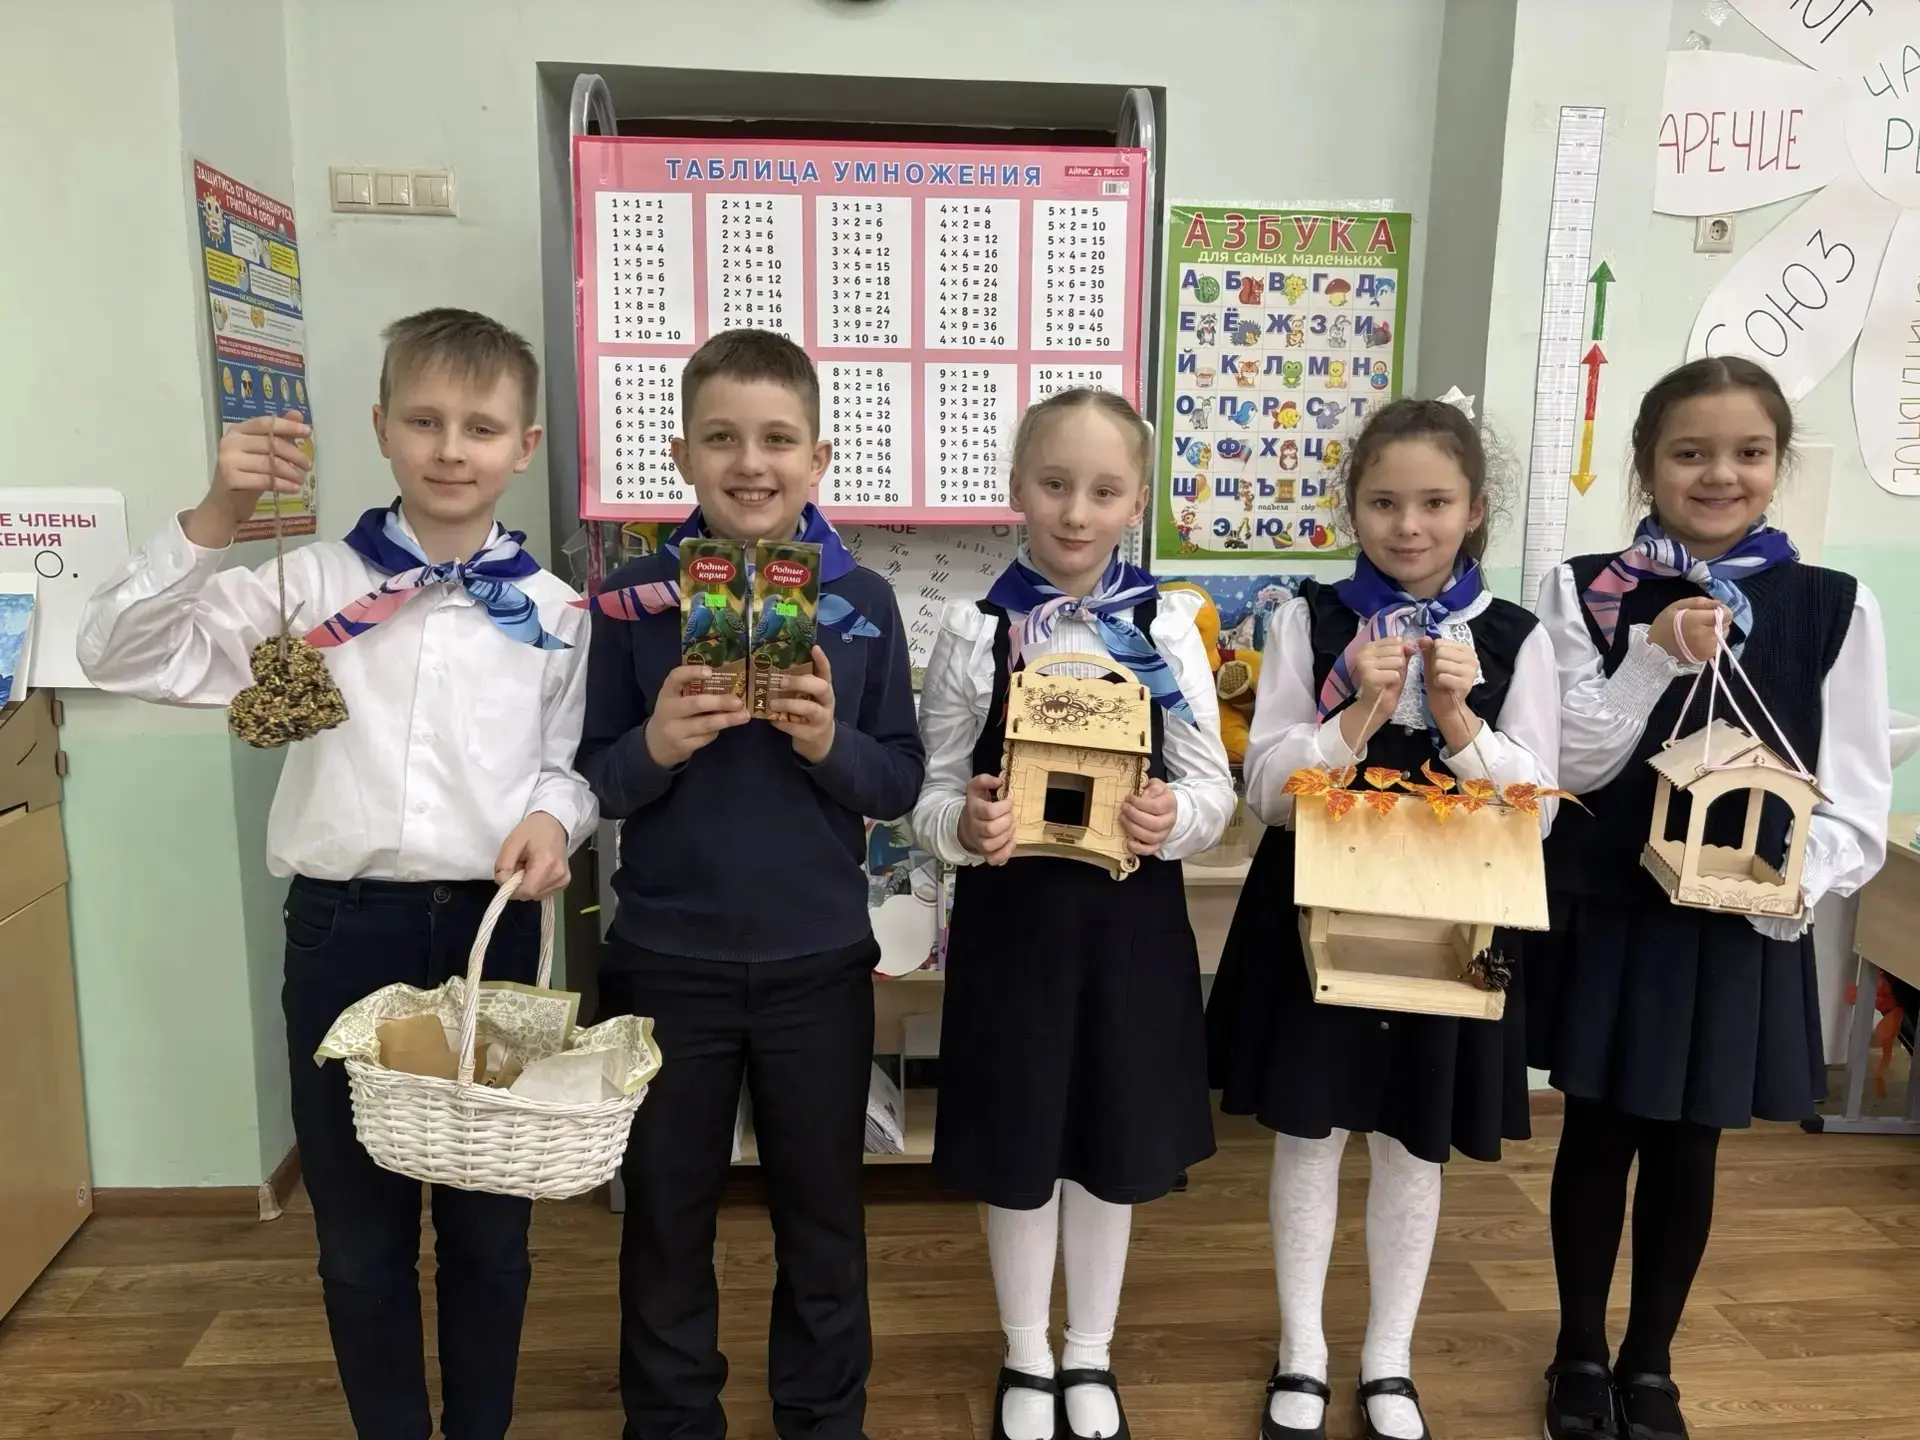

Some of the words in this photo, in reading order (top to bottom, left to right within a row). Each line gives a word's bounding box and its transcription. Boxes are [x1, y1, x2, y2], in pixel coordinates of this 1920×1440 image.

[665, 158, 820, 185] ТАБЛИЦА
[832, 161, 1042, 188] УМНОЖЕНИЯ
[1103, 168, 1125, 176] ПРЕСС
[612, 198, 618, 208] 1
[635, 199, 641, 208] 1
[657, 199, 663, 209] 1
[832, 217, 838, 227] 3
[854, 217, 861, 227] 2
[876, 217, 883, 227] 6
[1182, 212, 1396, 254] АЗБУКА
[940, 234, 947, 243] 4
[962, 234, 969, 244] 3
[985, 234, 998, 244] 12
[1198, 251, 1229, 263] для
[1234, 253, 1286, 264] самых
[1292, 254, 1382, 266] маленьких
[1047, 265, 1054, 274] 5
[1069, 265, 1076, 274] 5
[1090, 265, 1105, 275] 25
[1181, 269, 1198, 289] А
[1225, 271, 1241, 290] Б
[1268, 272, 1284, 291] В
[1312, 273, 1328, 292] Г
[1355, 274, 1375, 297] Д
[723, 288, 730, 298] 2
[746, 288, 752, 298] 7
[768, 289, 783, 299] 14
[1180, 312, 1196, 331] Е
[1223, 308, 1239, 332] Ё
[1266, 314, 1293, 333] Ж
[1309, 315, 1326, 334] З
[1354, 316, 1373, 335] И
[614, 329, 620, 338] 1
[637, 330, 651, 339] 10
[667, 330, 681, 340] 10
[832, 333, 839, 343] 3
[855, 334, 869, 343] 10
[884, 334, 898, 344] 30
[939, 335, 947, 344] 4
[962, 335, 976, 345] 10
[990, 336, 1005, 345] 40
[1046, 336, 1052, 346] 5
[1068, 337, 1082, 346] 10
[1096, 337, 1110, 347] 50
[1178, 349, 1196, 373] Й
[1221, 355, 1239, 374] К
[1263, 356, 1283, 375] Л
[1308, 357, 1330, 376] М
[1352, 358, 1370, 376] Н
[1039, 370, 1053, 380] 10
[1068, 371, 1073, 379] 1
[1089, 370, 1102, 380] 10
[939, 397, 946, 407] 9
[961, 397, 968, 407] 3
[983, 397, 996, 407] 27
[1176, 395, 1194, 415] О
[1219, 397, 1237, 415] П
[1262, 397, 1279, 416] Р
[1306, 397, 1323, 416] С
[1350, 398, 1366, 417] Т
[1174, 437, 1191, 456] У
[1217, 437, 1241, 457] Ф
[1259, 438, 1278, 457] Х
[1304, 438, 1322, 460] Ц
[833, 451, 841, 461] 8
[856, 451, 862, 461] 7
[877, 452, 891, 461] 56
[1173, 478, 1197, 497] Ш
[1215, 478, 1239, 499] Щ
[1257, 478, 1275, 497] Ъ
[1301, 479, 1326, 497] Ы
[616, 490, 623, 500] 6
[639, 490, 653, 500] 10
[668, 490, 683, 500] 60
[833, 492, 841, 502] 8
[856, 493, 870, 502] 10
[884, 493, 899, 502] 80
[940, 493, 947, 503] 9
[962, 493, 976, 503] 10
[990, 493, 1005, 503] 90
[19, 513, 97, 528] ЧЛЕНЫ
[1213, 518, 1231, 536] Э
[1256, 518, 1283, 537] Ю
[1298, 518, 1315, 536] Я
[696, 561, 729, 572] Родные
[771, 564, 804, 576] Родные
[698, 571, 727, 581] корма
[773, 574, 801, 584] корма
